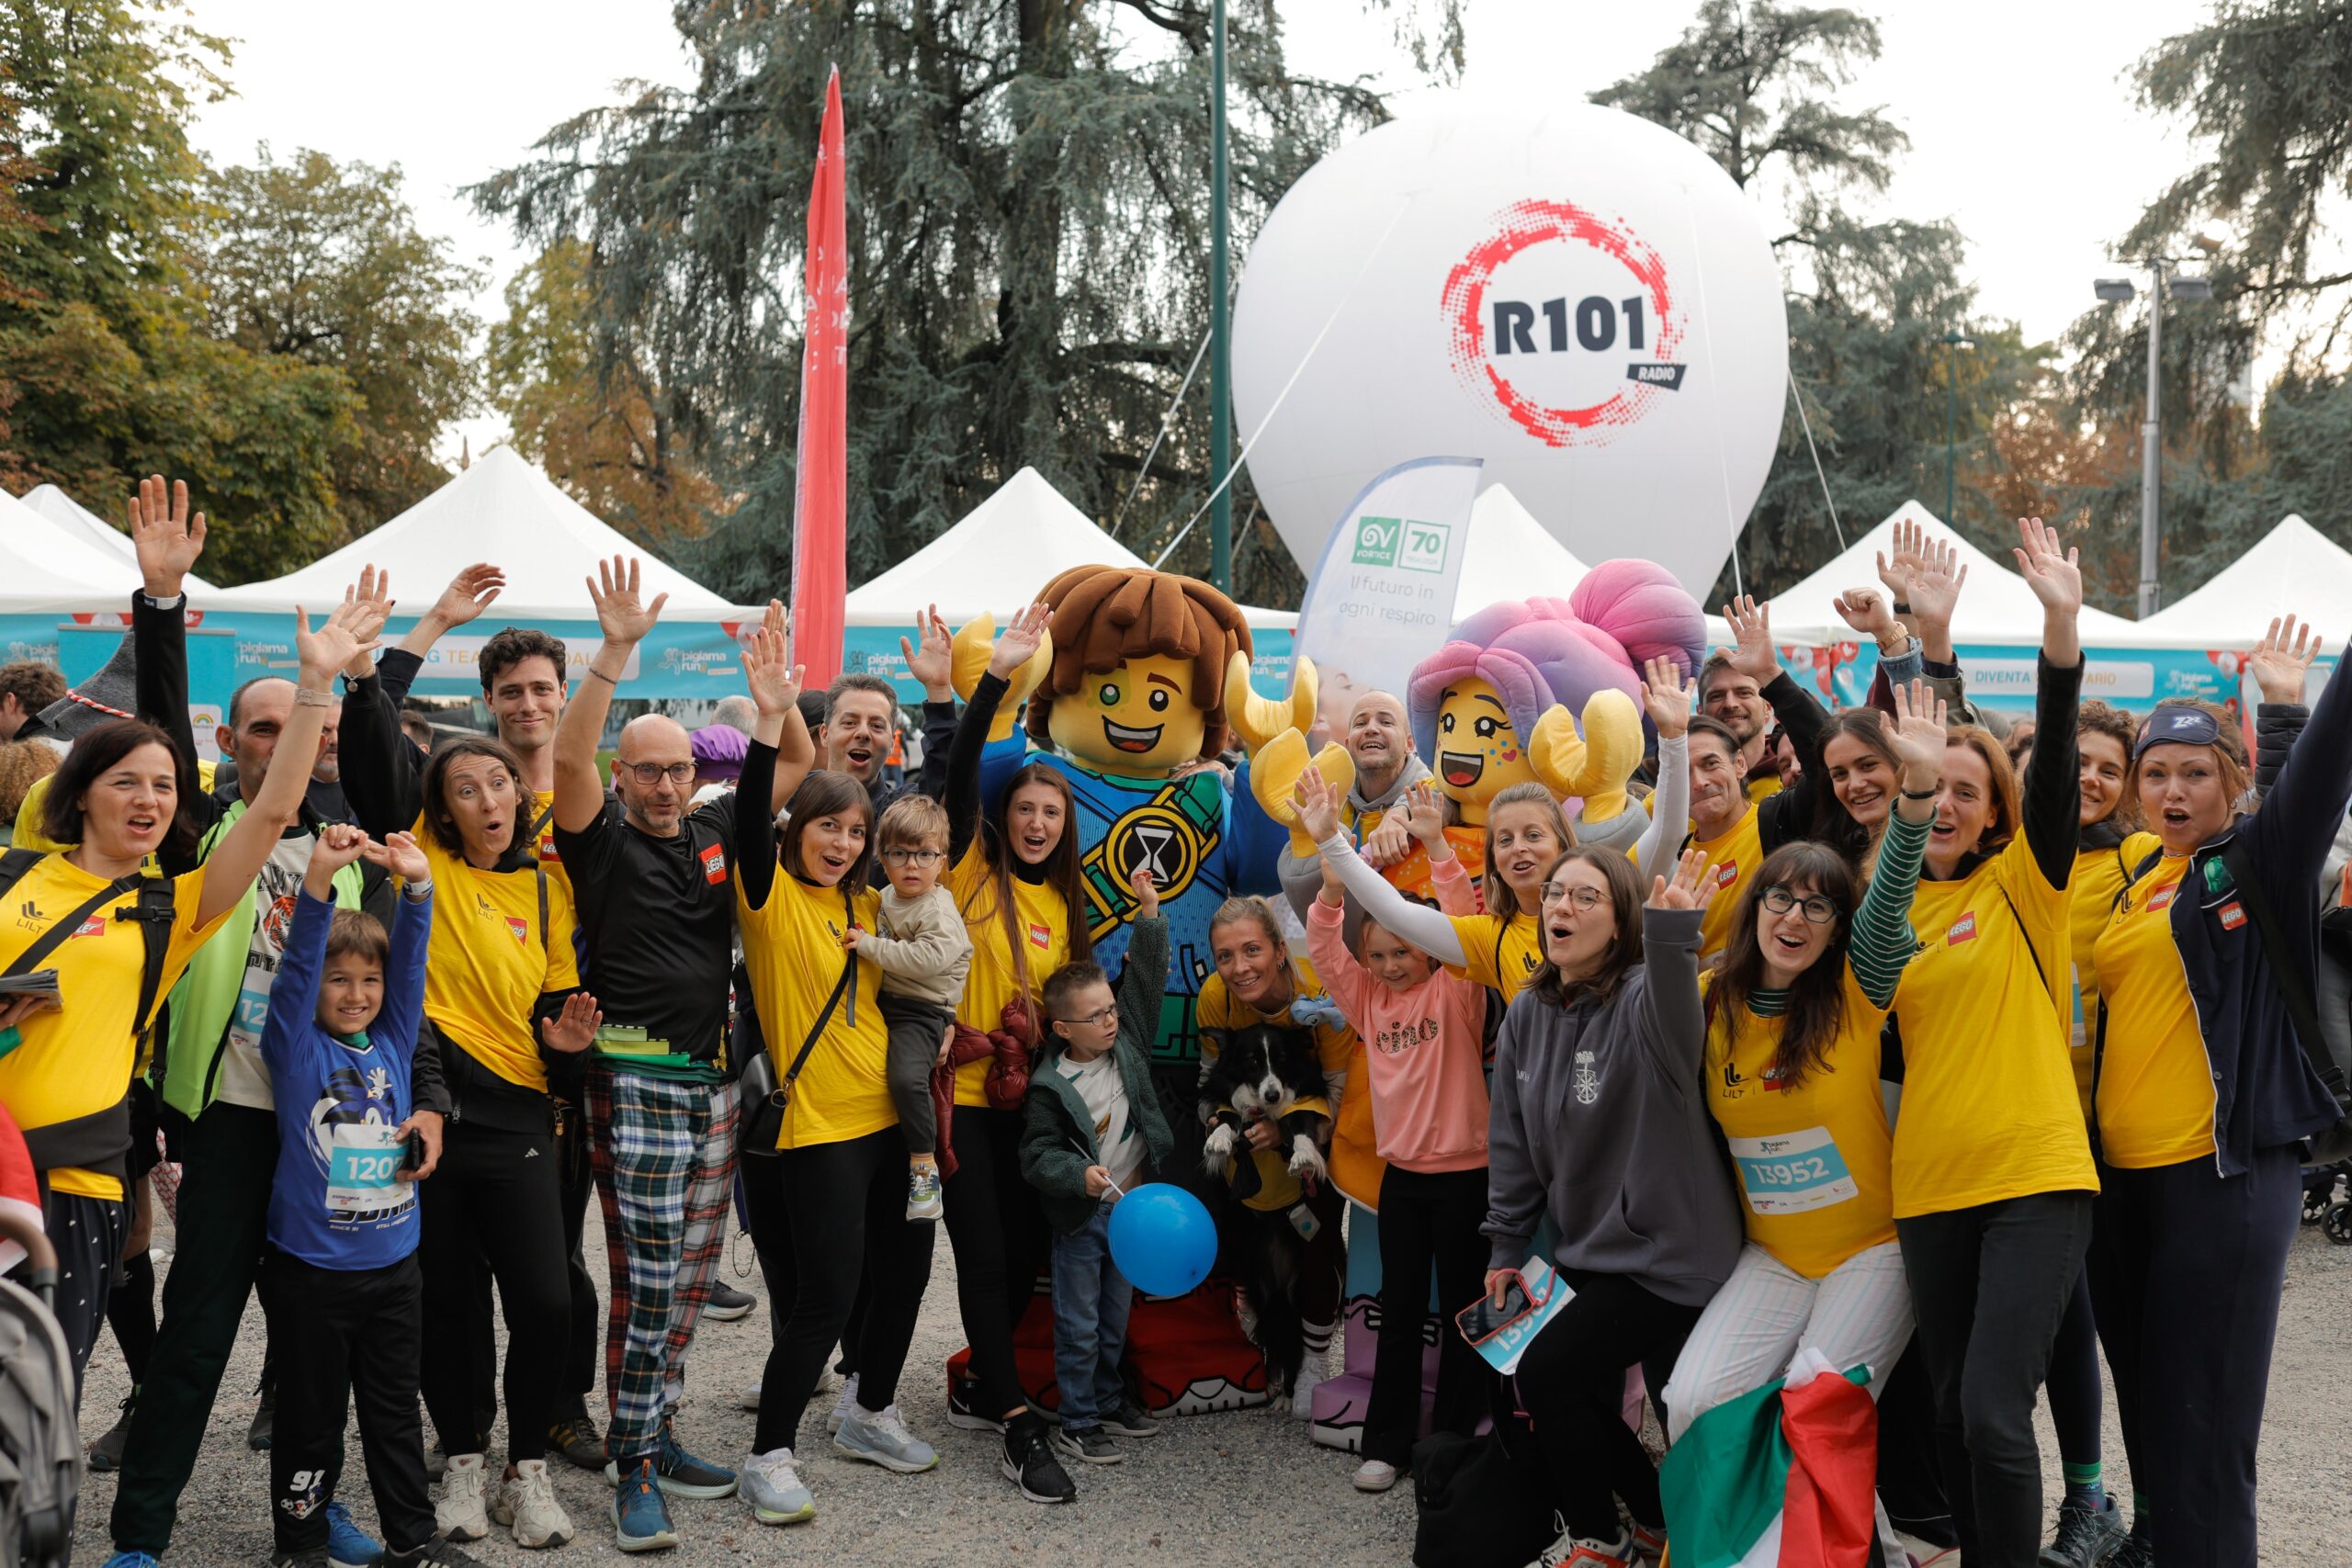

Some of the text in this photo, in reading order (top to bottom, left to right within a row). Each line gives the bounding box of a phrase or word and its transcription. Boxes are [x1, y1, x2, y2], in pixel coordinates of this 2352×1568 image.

[1493, 295, 1645, 355] R101
[1638, 366, 1676, 382] RADIO
[1411, 530, 1441, 555] 70
[1363, 576, 1414, 598] futuro
[1418, 583, 1434, 601] in
[1339, 602, 1436, 626] ogni respiro
[682, 661, 701, 671] run
[867, 653, 908, 666] pigiam
[1975, 671, 2030, 683] DIVENTA
[706, 853, 726, 875] LEGO
[1719, 866, 1737, 882] LEGO
[2222, 907, 2243, 923] LEGO
[17, 918, 44, 934] LILT
[1949, 918, 1974, 937] LEGO
[1031, 929, 1049, 943] LEGO
[1375, 1018, 1439, 1054] ciao
[1723, 1089, 1746, 1100] LILT
[1750, 1156, 1830, 1186] 13952
[289, 1469, 325, 1492] 91
